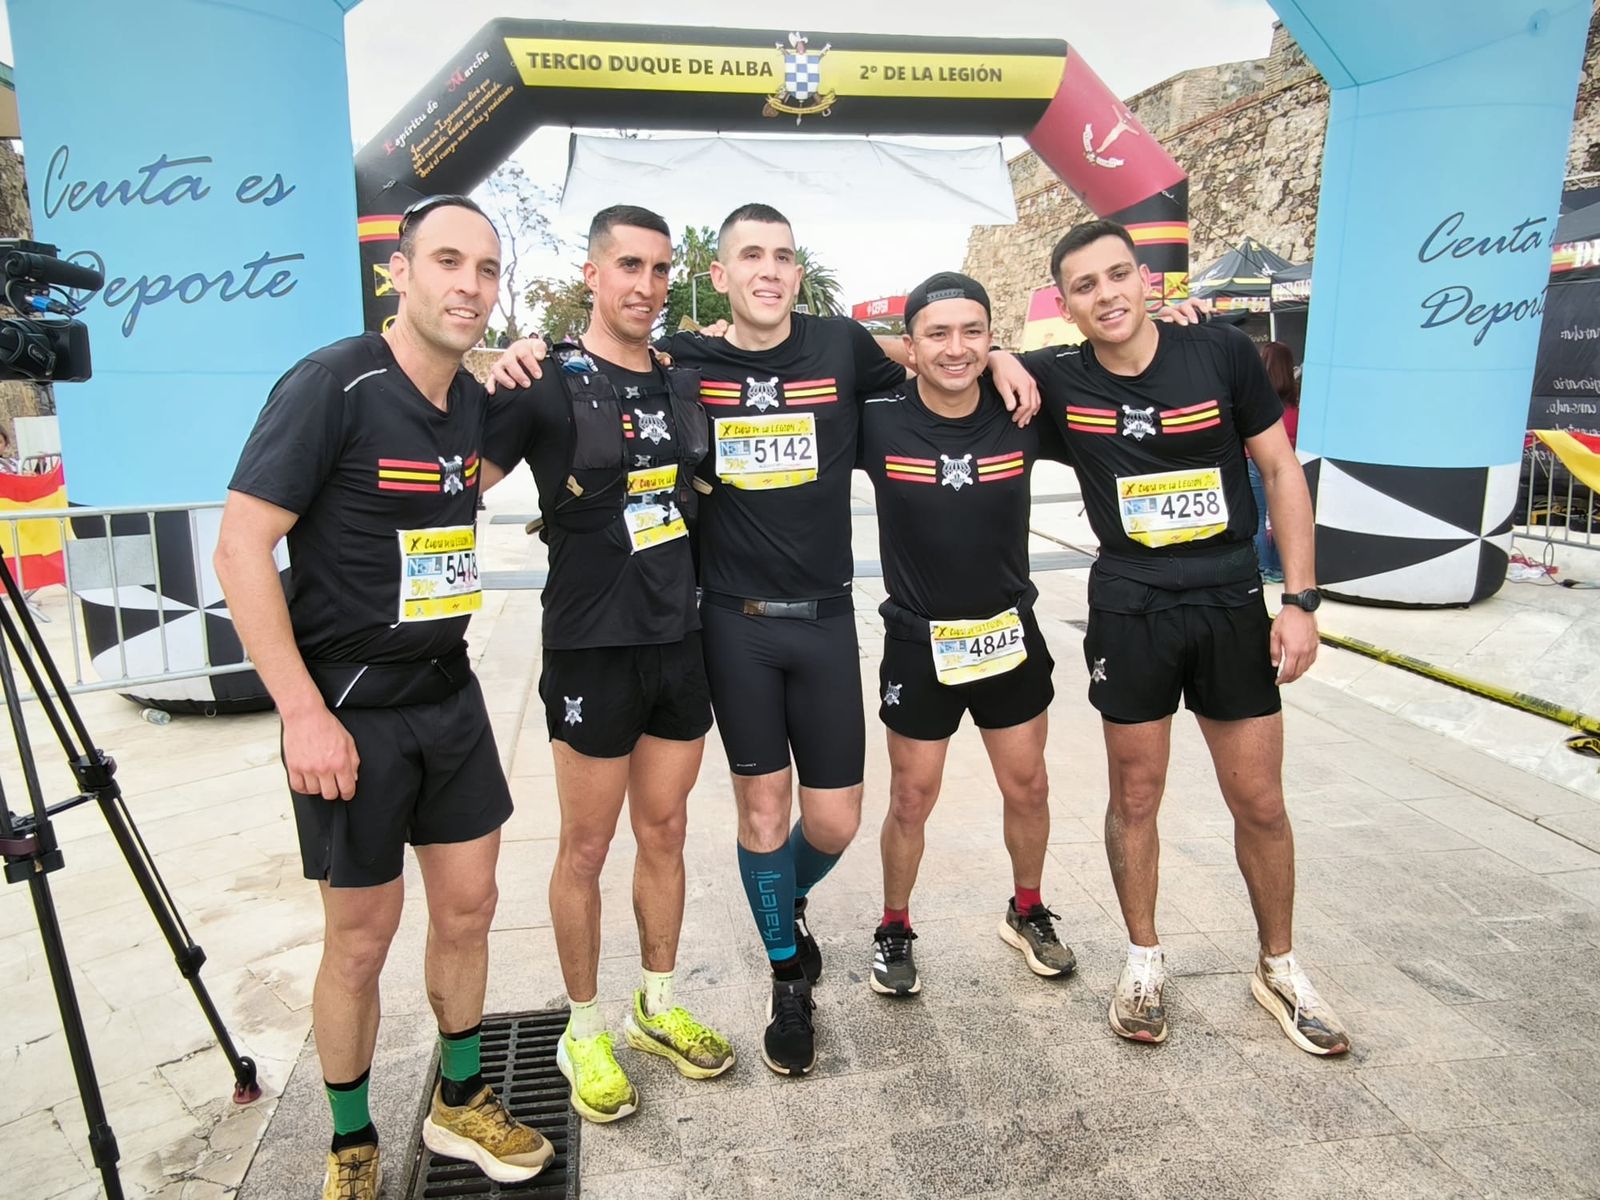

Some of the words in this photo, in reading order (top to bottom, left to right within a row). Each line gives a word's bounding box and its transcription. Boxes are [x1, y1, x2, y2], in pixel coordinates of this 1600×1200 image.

[526, 52, 602, 71] TERCIO
[608, 55, 682, 75] DUQUE
[688, 59, 714, 75] DE
[720, 60, 773, 77] ALBA
[884, 66, 906, 81] DE
[912, 66, 933, 81] LA
[939, 64, 1003, 83] LEGIÓN
[427, 101, 438, 114] de
[449, 51, 490, 92] Marcha
[235, 173, 296, 206] es
[755, 437, 812, 463] 5142
[1161, 491, 1220, 519] 4258
[446, 552, 478, 584] 5478
[969, 628, 1020, 657] 4845
